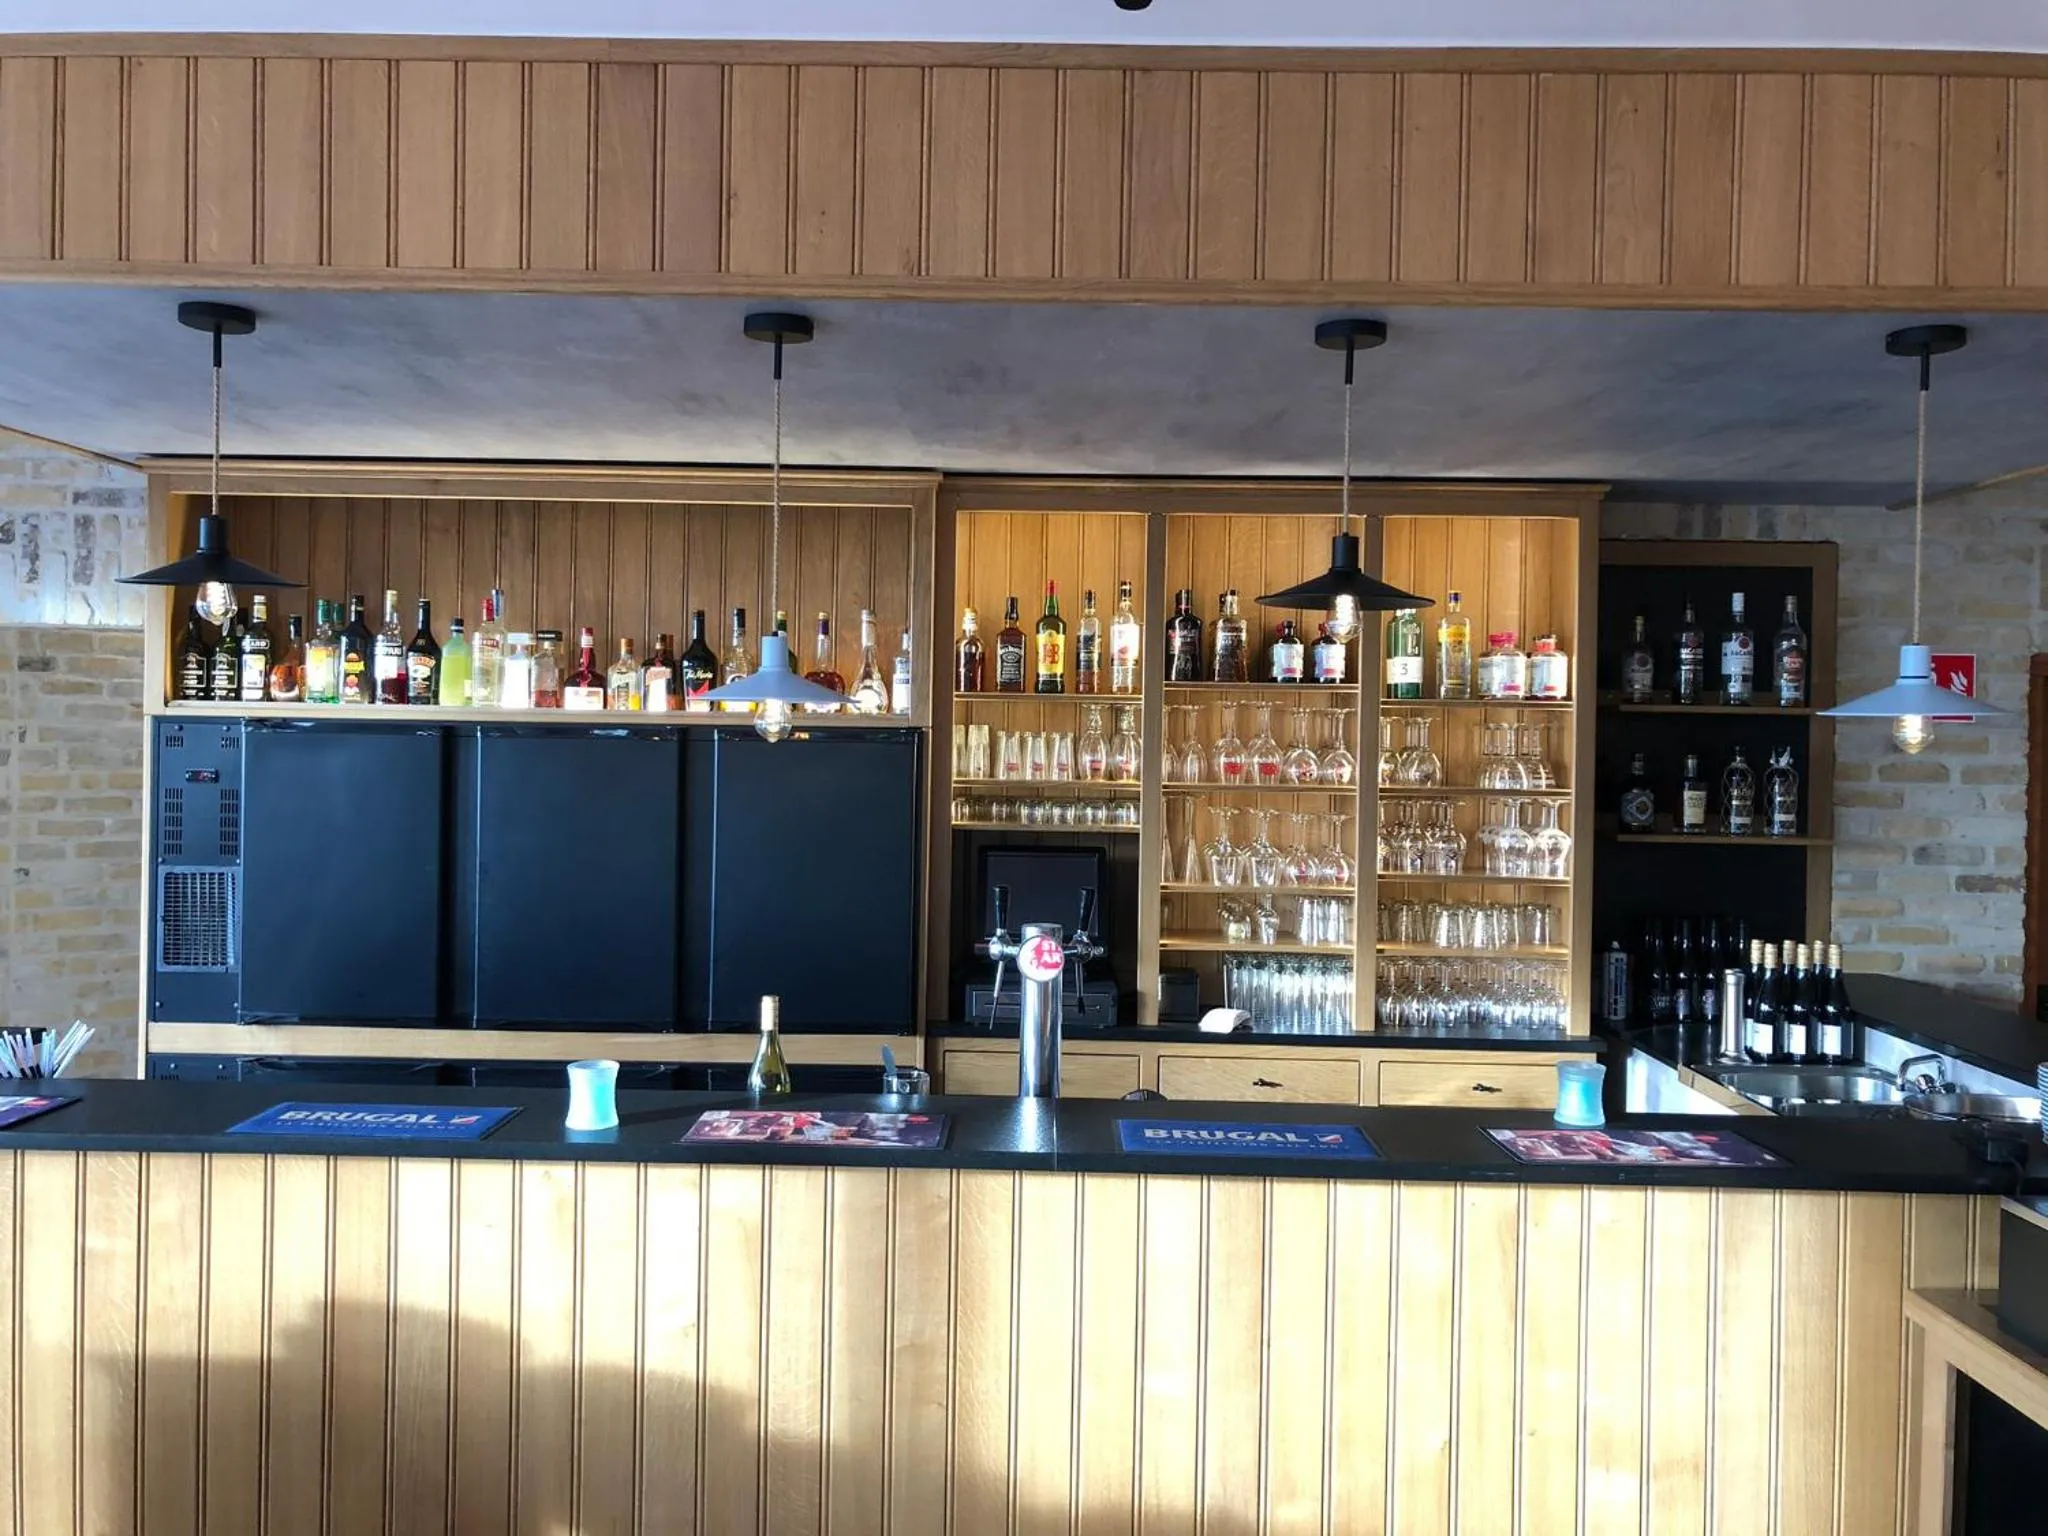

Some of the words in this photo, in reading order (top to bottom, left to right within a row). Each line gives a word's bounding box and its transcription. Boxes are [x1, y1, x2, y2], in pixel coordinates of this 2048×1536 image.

[1399, 662, 1409, 676] 3
[276, 1109, 441, 1124] BRUGAL
[1143, 1127, 1309, 1143] BRUGAL
